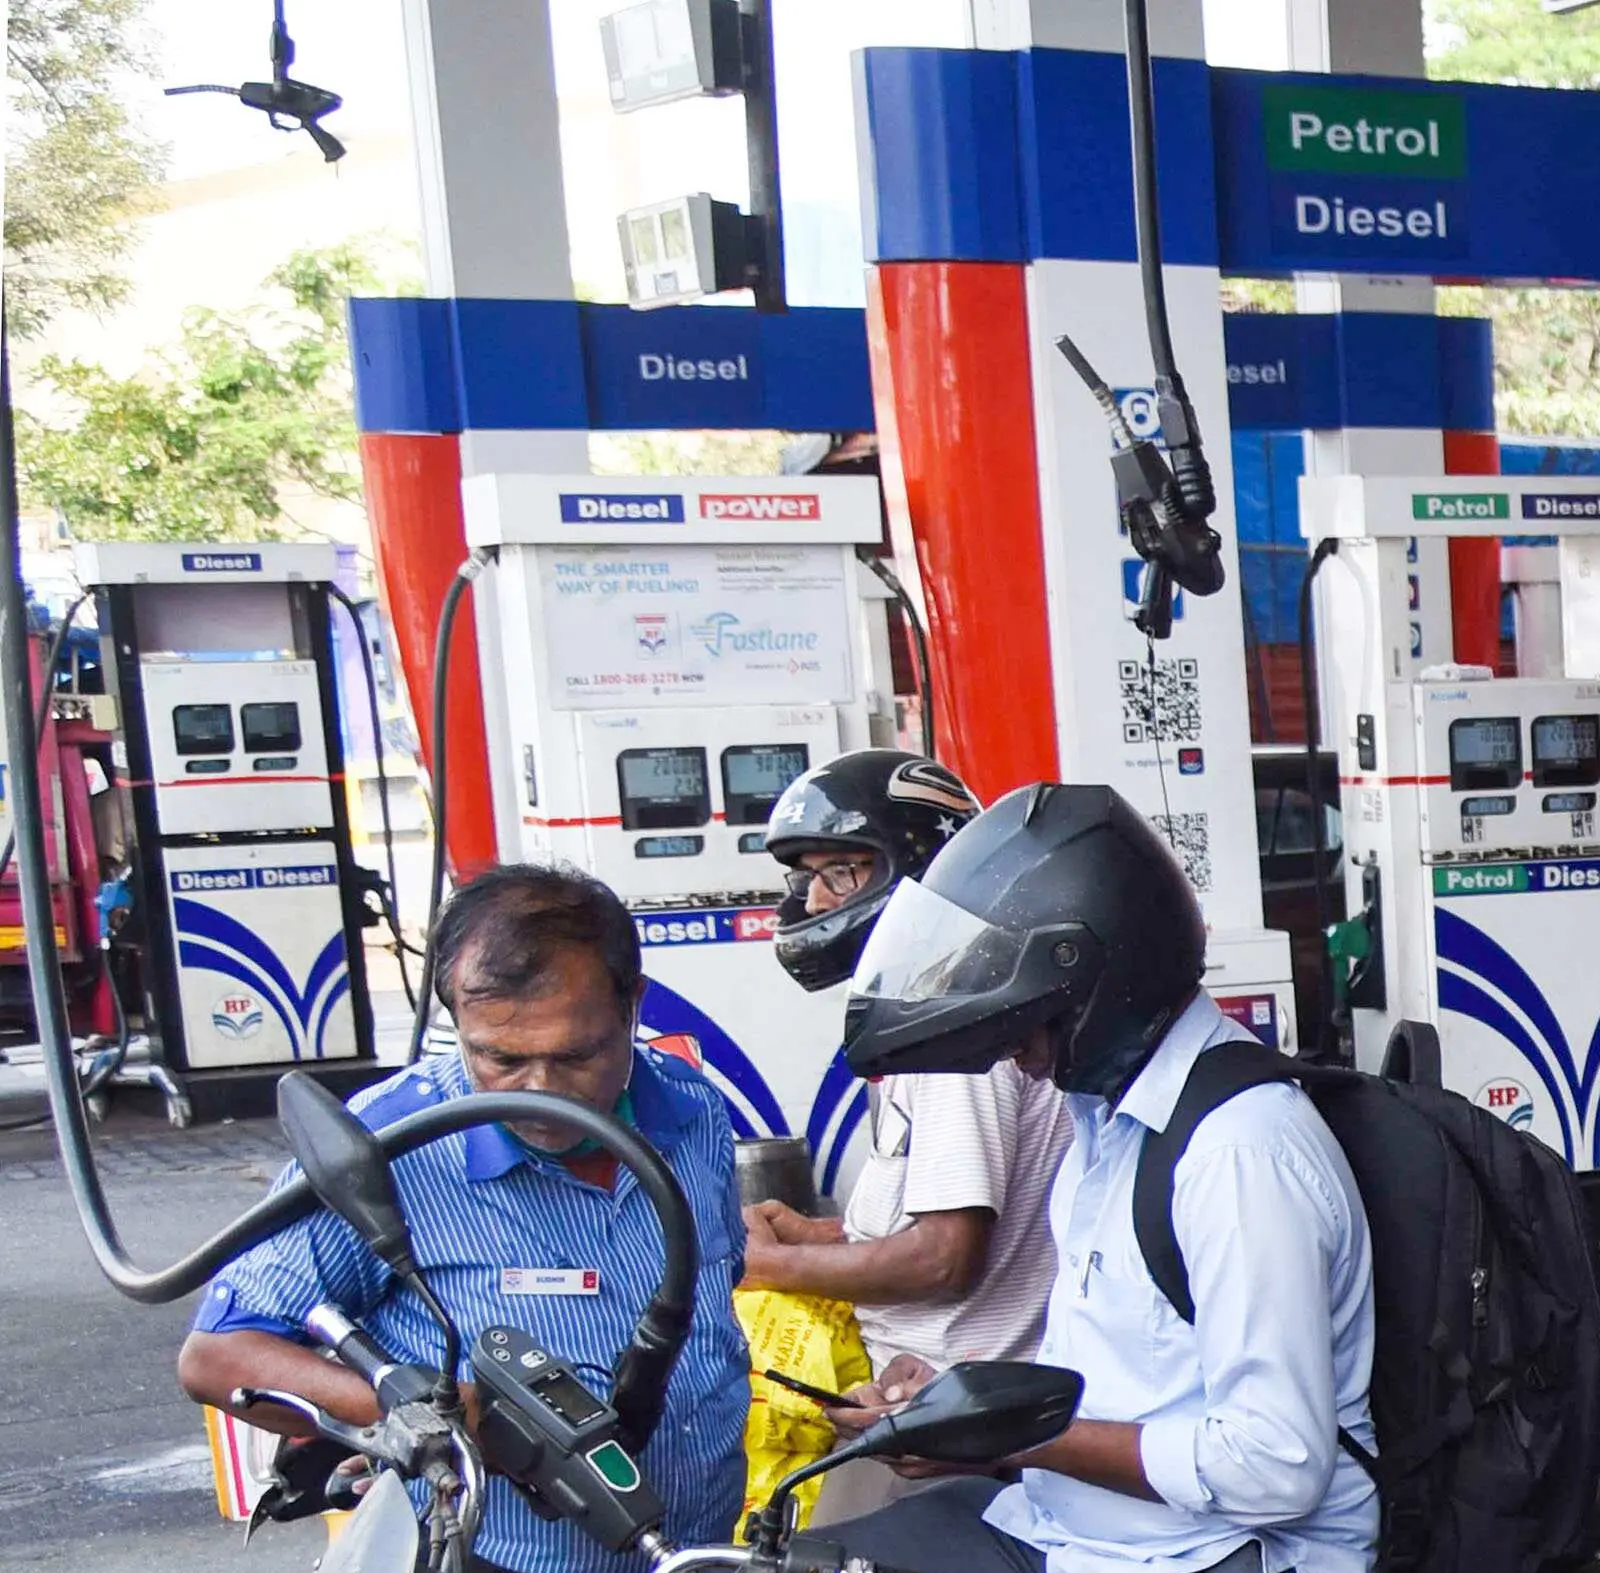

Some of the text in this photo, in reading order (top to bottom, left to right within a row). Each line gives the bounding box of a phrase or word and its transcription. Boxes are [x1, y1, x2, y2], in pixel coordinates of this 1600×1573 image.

[1291, 112, 1440, 156] Petrol
[1296, 196, 1448, 238] Diesel
[640, 353, 748, 382] Diesel
[1227, 361, 1286, 385] esel
[578, 496, 669, 520] Diesel
[1427, 499, 1495, 516] Petrol
[193, 553, 252, 572] Diesel
[555, 562, 670, 577] THE SMARTER
[556, 580, 596, 595] WAY
[601, 580, 620, 594] OF
[178, 869, 247, 890] Diesel
[262, 865, 330, 886] Diesel
[1446, 870, 1514, 889] Petrol
[636, 914, 717, 944] iesel
[1488, 1087, 1519, 1106] HP
